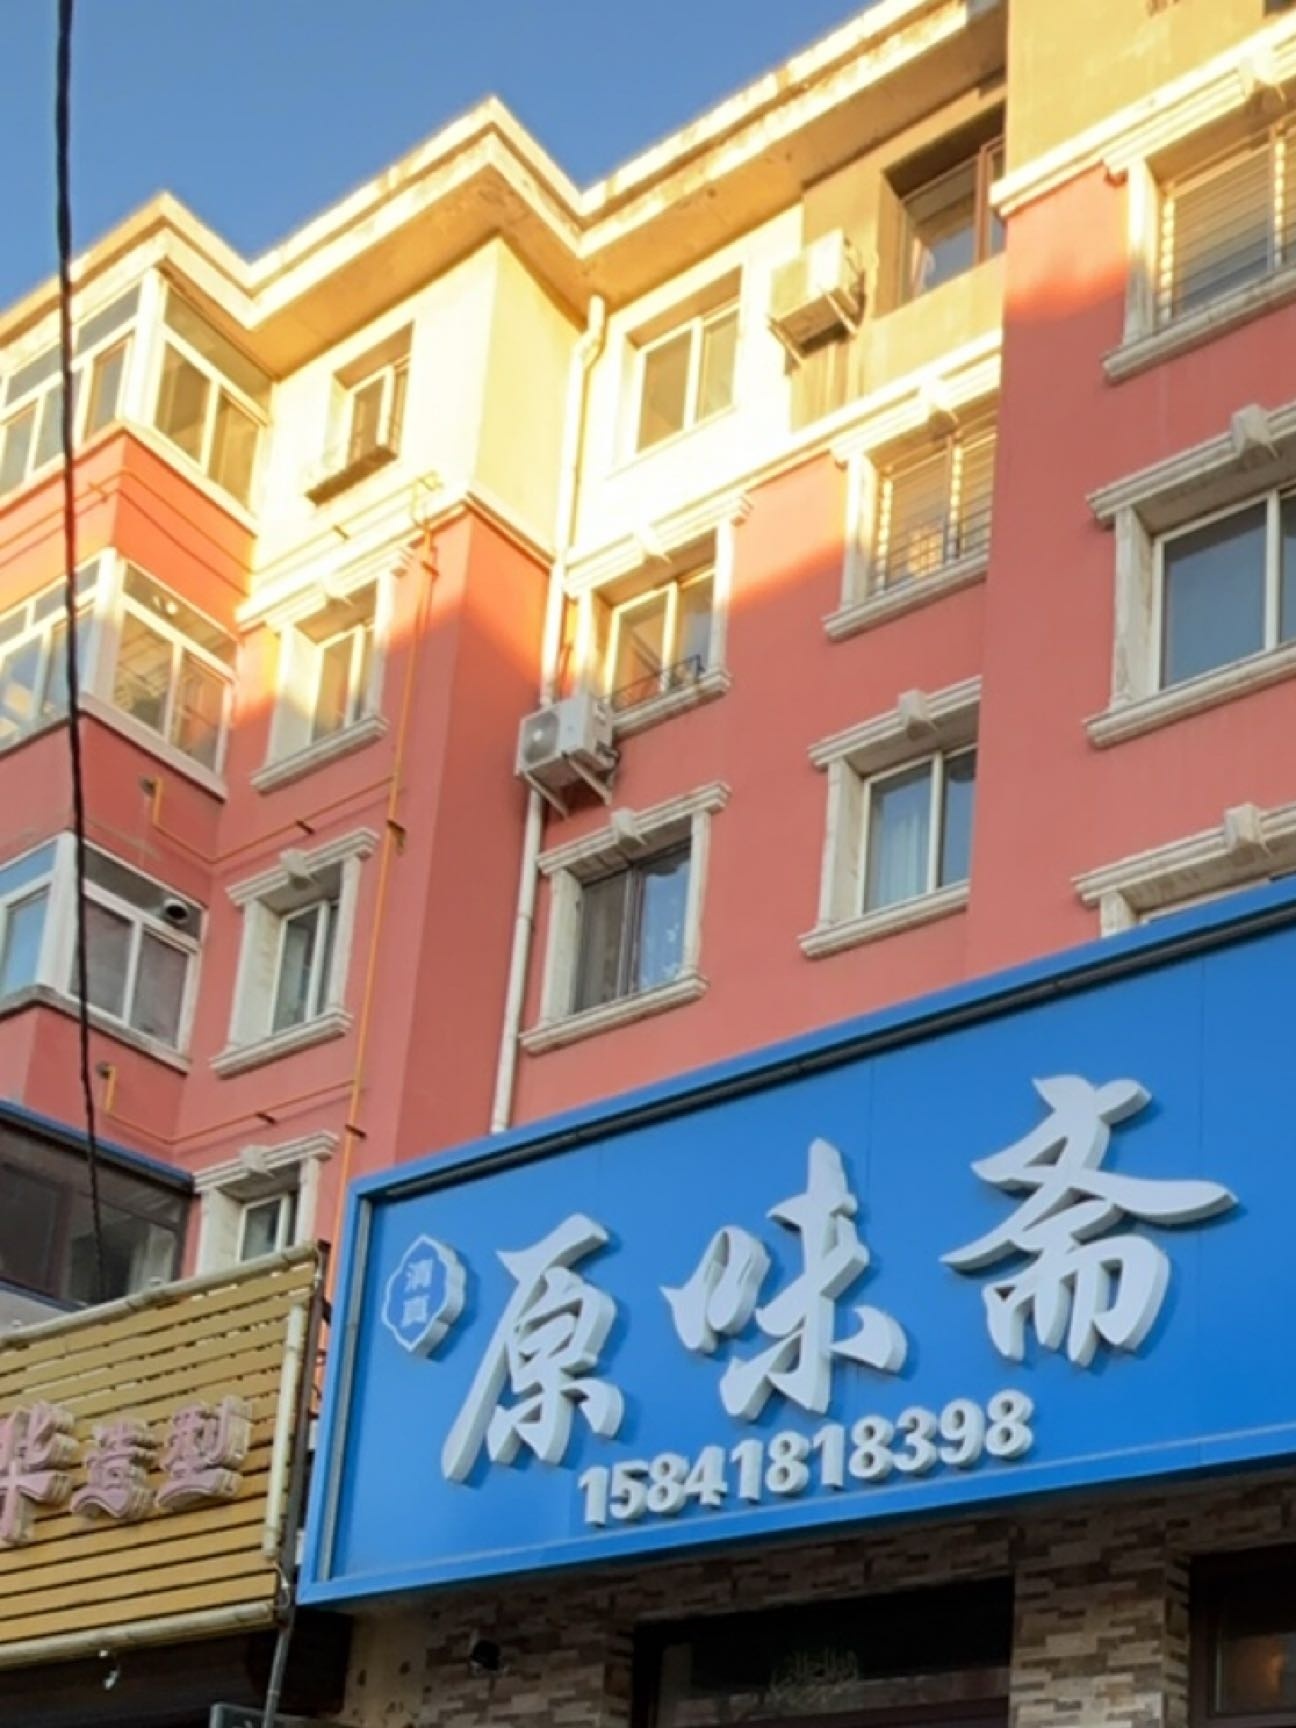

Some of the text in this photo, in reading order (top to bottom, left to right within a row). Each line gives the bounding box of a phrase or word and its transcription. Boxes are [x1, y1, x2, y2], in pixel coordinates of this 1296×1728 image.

[442, 1074, 1237, 1482] 原味斋
[580, 1389, 1035, 1526] 15841818398
